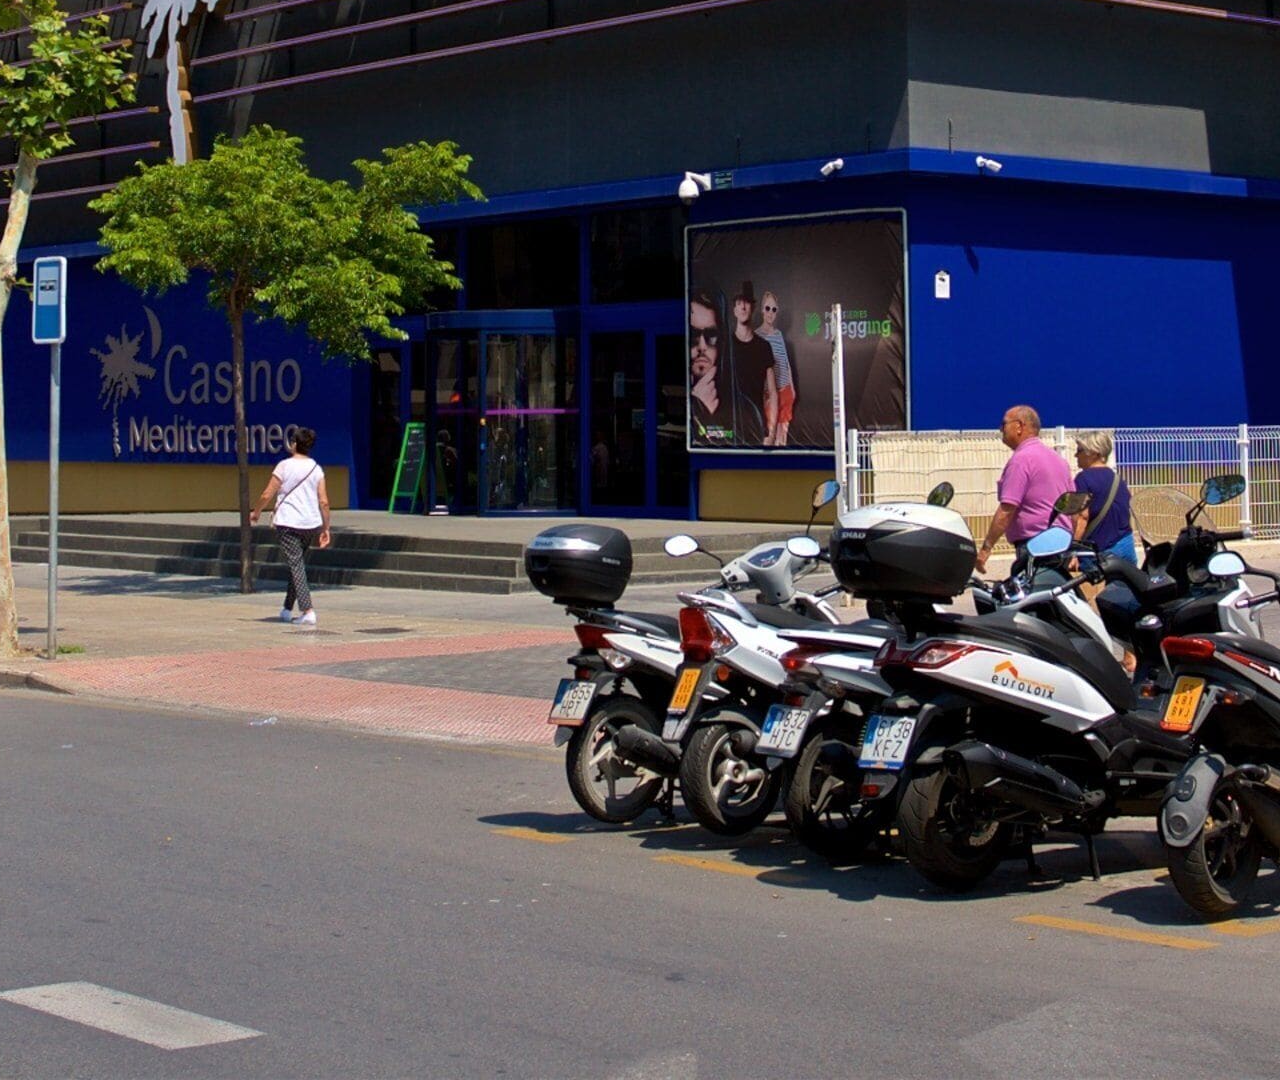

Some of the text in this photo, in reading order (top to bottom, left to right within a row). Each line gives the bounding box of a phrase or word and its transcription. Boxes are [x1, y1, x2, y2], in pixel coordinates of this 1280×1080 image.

[164, 344, 302, 405] Casno
[129, 415, 300, 454] Mediterrneo
[876, 719, 913, 739] 6138
[872, 738, 903, 759] KFZ
